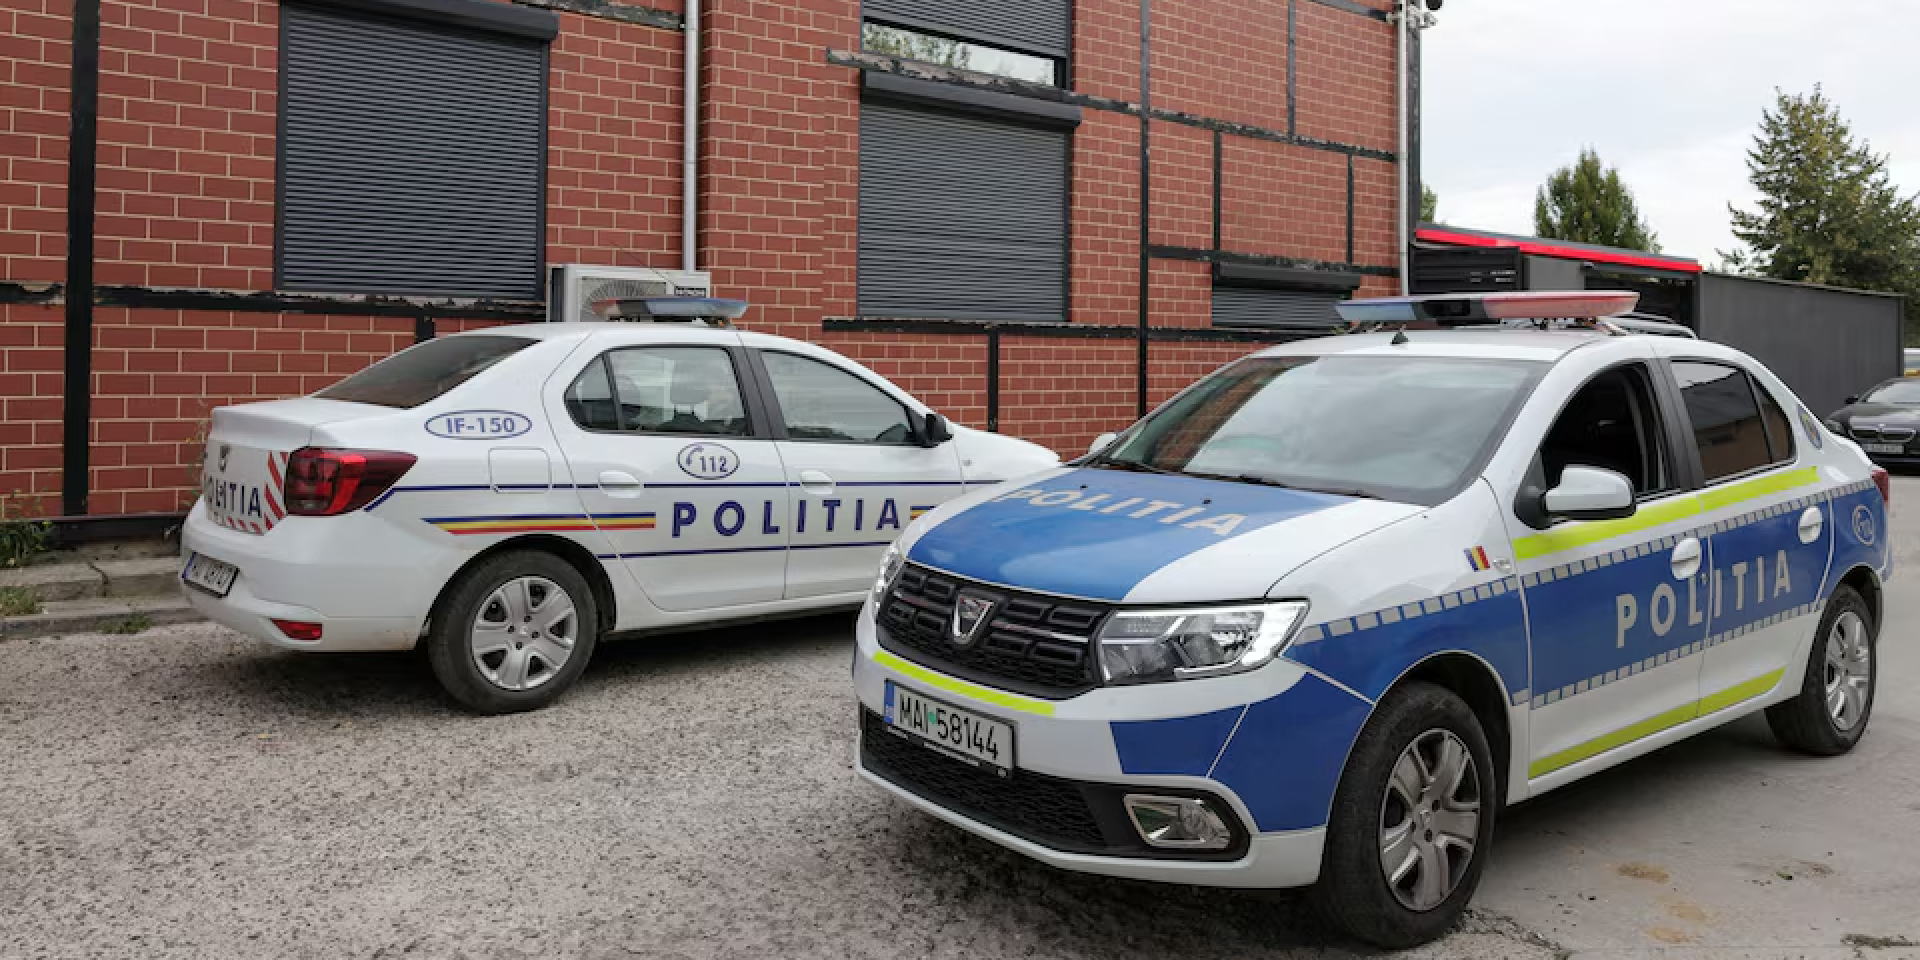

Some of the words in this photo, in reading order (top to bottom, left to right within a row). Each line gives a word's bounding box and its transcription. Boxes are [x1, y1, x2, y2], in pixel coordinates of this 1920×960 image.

[446, 417, 515, 433] IF-150
[699, 456, 728, 473] 112
[672, 499, 900, 538] POLITIA
[993, 489, 1248, 536] POLITIA
[1615, 549, 1791, 649] POLITIA
[900, 693, 929, 734] MAI
[936, 707, 998, 761] 58144
